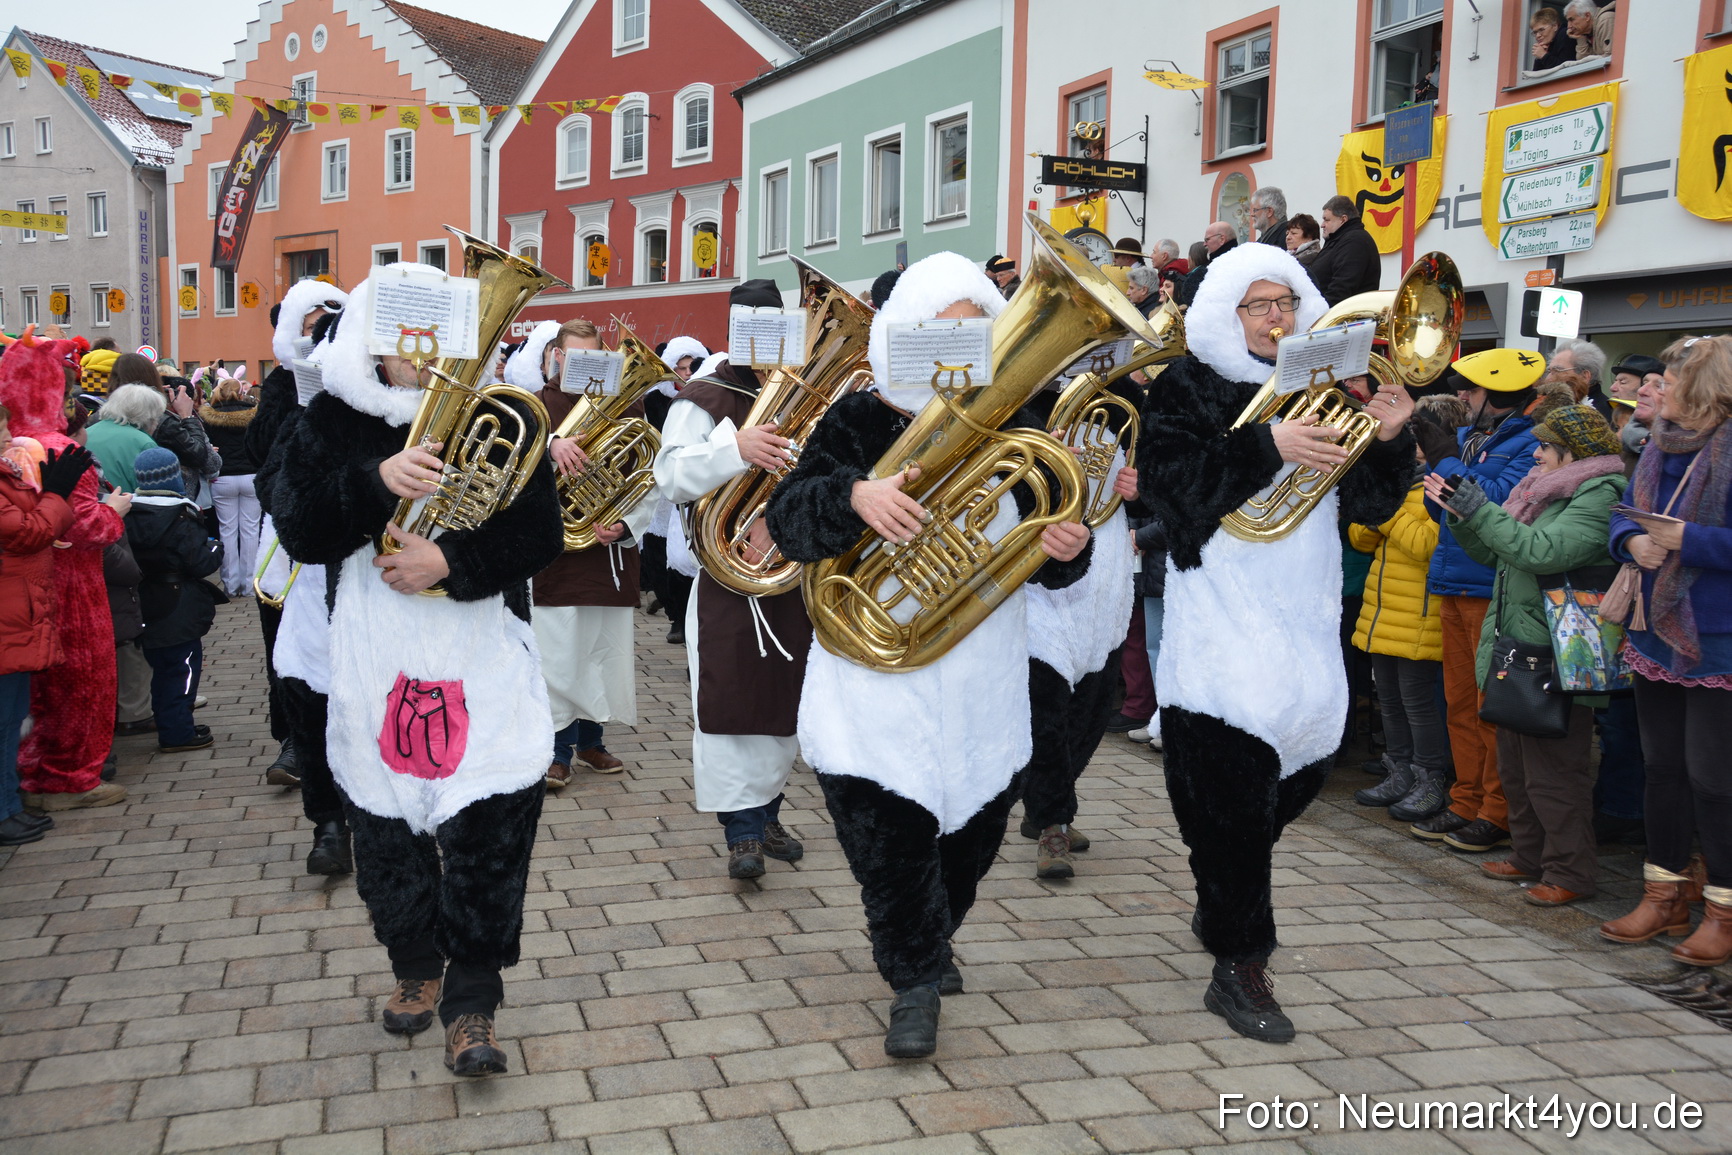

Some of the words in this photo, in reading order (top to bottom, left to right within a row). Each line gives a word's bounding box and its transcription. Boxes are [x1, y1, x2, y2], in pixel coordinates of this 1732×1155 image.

[1523, 124, 1563, 141] Beilngries
[1523, 148, 1549, 162] Töging
[1053, 161, 1136, 179] RÖHLICH
[1519, 175, 1562, 192] Riedenburg
[1516, 198, 1552, 212] Mühlbach
[139, 211, 149, 265] UHREN
[1517, 226, 1547, 239] Parsberg
[1583, 221, 1592, 229] km
[1516, 240, 1559, 254] Breitenbrunn
[1581, 237, 1591, 245] km
[141, 272, 150, 346] SCHMUCK
